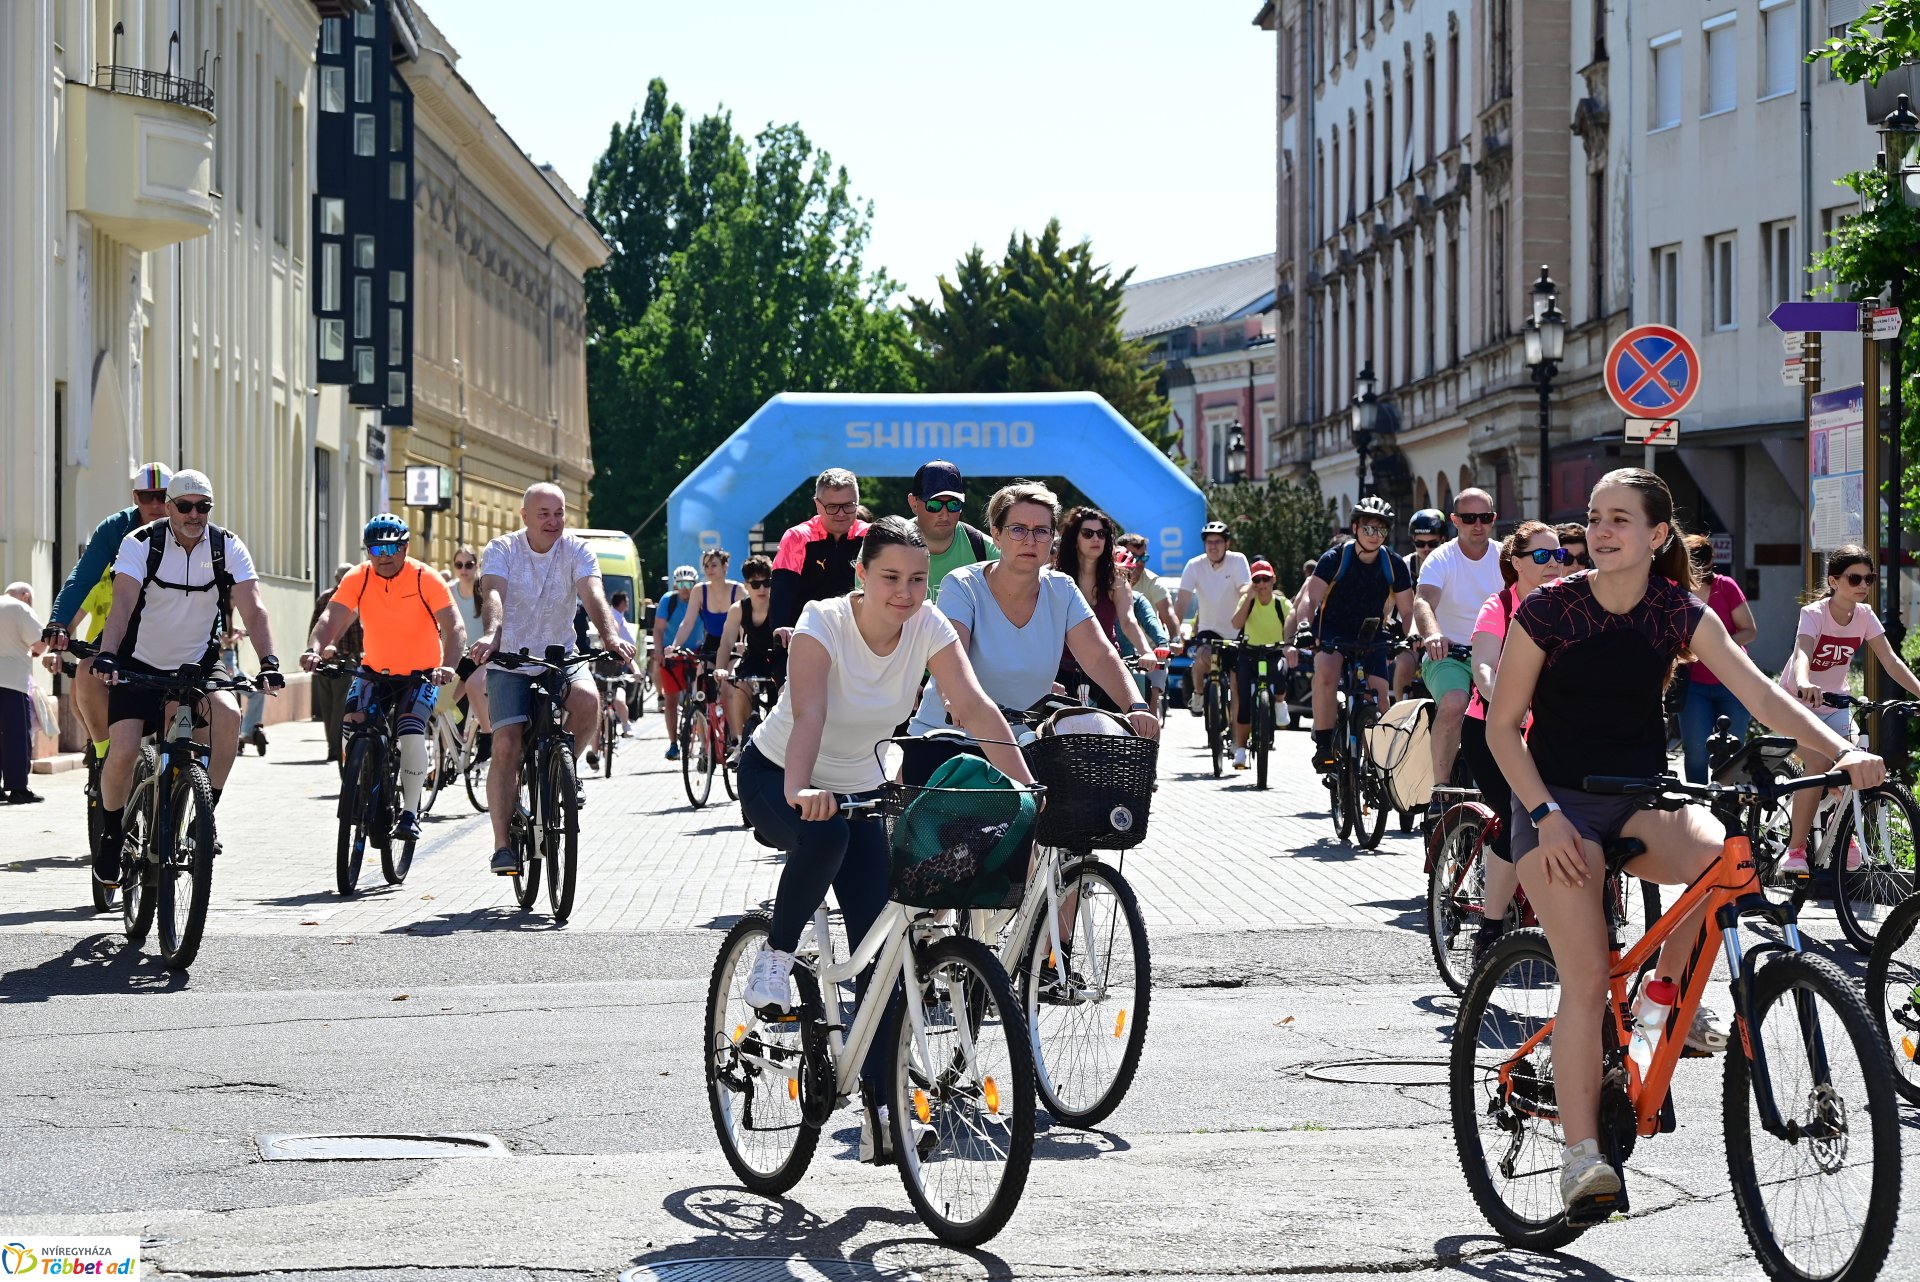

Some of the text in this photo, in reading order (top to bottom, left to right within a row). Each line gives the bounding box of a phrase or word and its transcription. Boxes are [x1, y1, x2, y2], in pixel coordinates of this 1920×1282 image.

[846, 421, 1035, 448] SHIMANO
[1712, 538, 1730, 548] ÁZZ
[1458, 956, 1498, 1034] SCHWALBE
[1735, 1182, 1778, 1269] SCHWALBE
